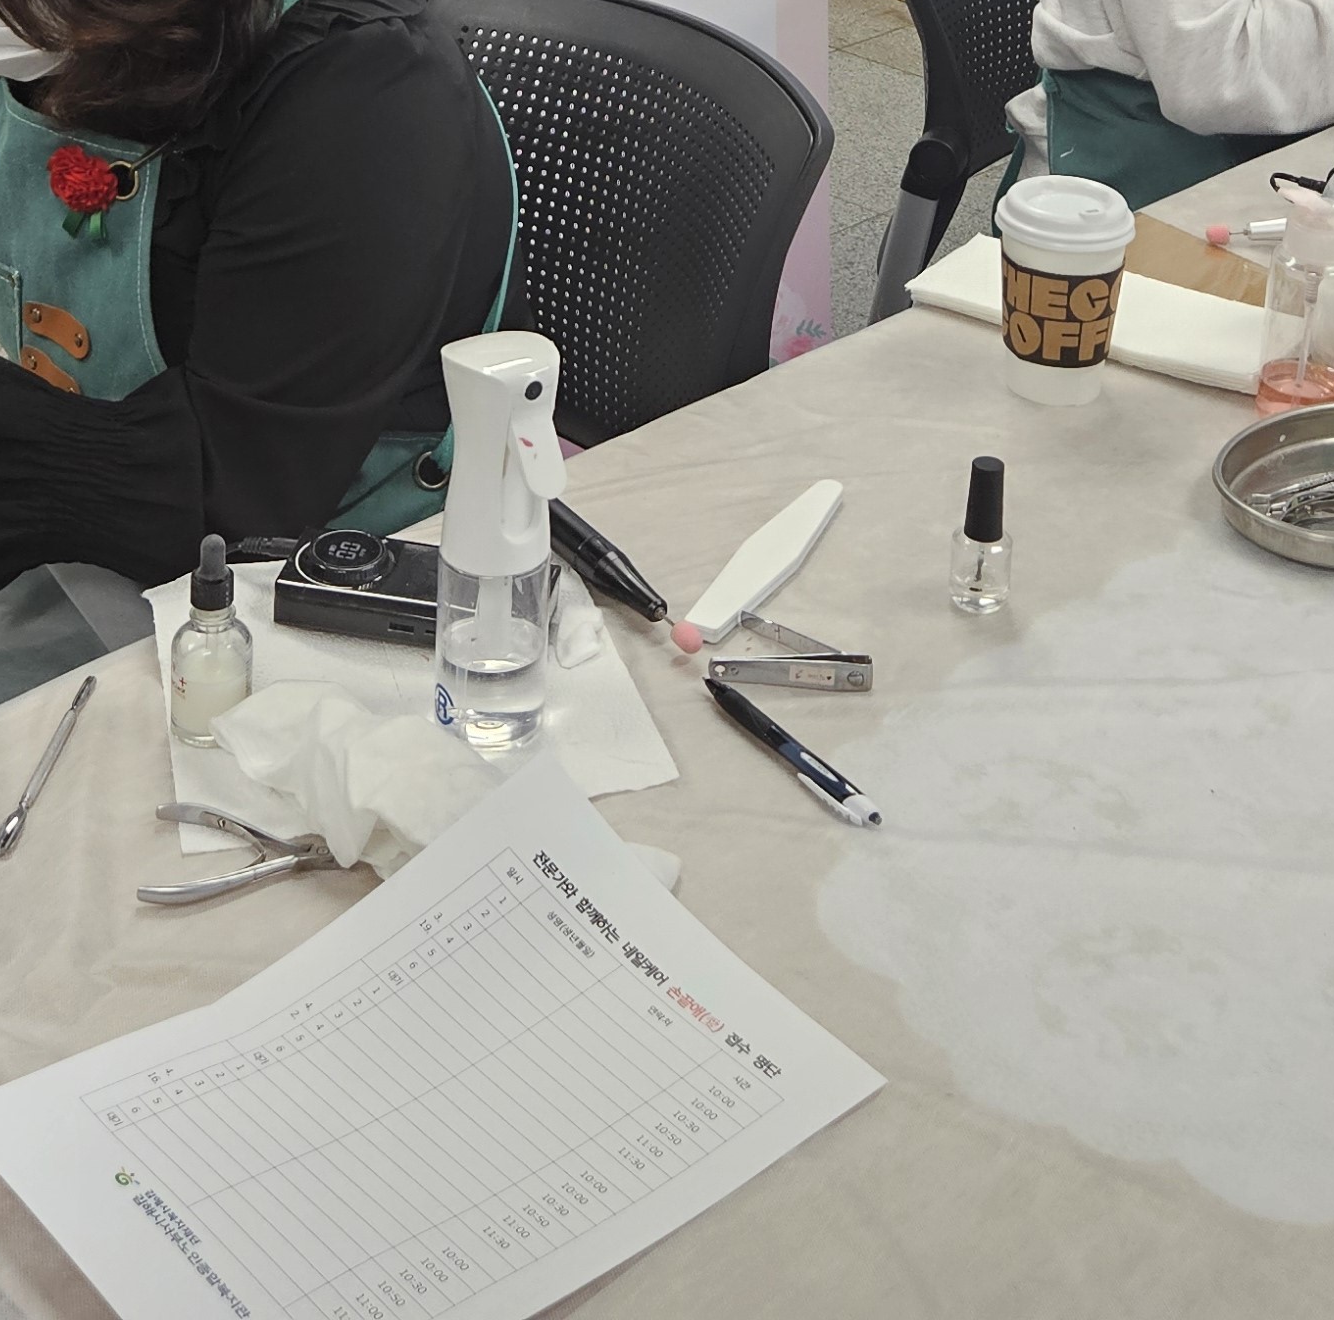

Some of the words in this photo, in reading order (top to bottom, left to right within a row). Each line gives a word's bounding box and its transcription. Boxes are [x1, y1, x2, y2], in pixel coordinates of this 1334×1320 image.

[1003, 300, 1115, 361] OFF
[505, 865, 524, 886] 일시
[498, 896, 508, 906] 1
[481, 908, 491, 918] 2
[463, 921, 474, 932] 3
[445, 935, 455, 945] 4
[427, 948, 437, 957] 5
[409, 960, 419, 970] 6
[532, 849, 578, 899] 전문가와
[575, 897, 621, 944] 함께하는
[621, 941, 670, 987] 네일케어
[724, 1032, 751, 1056] 접수
[753, 1054, 783, 1079] 명단
[372, 986, 381, 996] 1
[353, 998, 363, 1008] 2
[334, 1010, 344, 1020] 3
[295, 1034, 306, 1043] 5
[316, 1023, 325, 1032] 4
[275, 1045, 285, 1053] 6
[215, 1071, 226, 1079] 2
[235, 1063, 246, 1071] 1
[174, 1088, 184, 1096] 4
[194, 1079, 206, 1088] 3
[152, 1096, 164, 1105] 5
[708, 1085, 736, 1109] 10:00
[131, 1105, 142, 1114] 6
[691, 1098, 718, 1121] 10:00
[673, 1110, 700, 1134] 10:30
[654, 1122, 682, 1146] 10:50
[636, 1134, 664, 1158] 11:00
[618, 1146, 646, 1171] 11:30
[580, 1170, 608, 1194] 10:00
[561, 1182, 589, 1205] 10:00
[523, 1204, 550, 1228] 10:50
[542, 1193, 570, 1217] 10:30
[483, 1226, 511, 1250] 11:30
[503, 1215, 531, 1239] 11:00
[420, 1257, 449, 1283] 10:00
[442, 1246, 470, 1272] 10:00
[399, 1269, 428, 1295] 10:30
[377, 1280, 406, 1307] 10:50
[356, 1292, 384, 1320] 11:00
